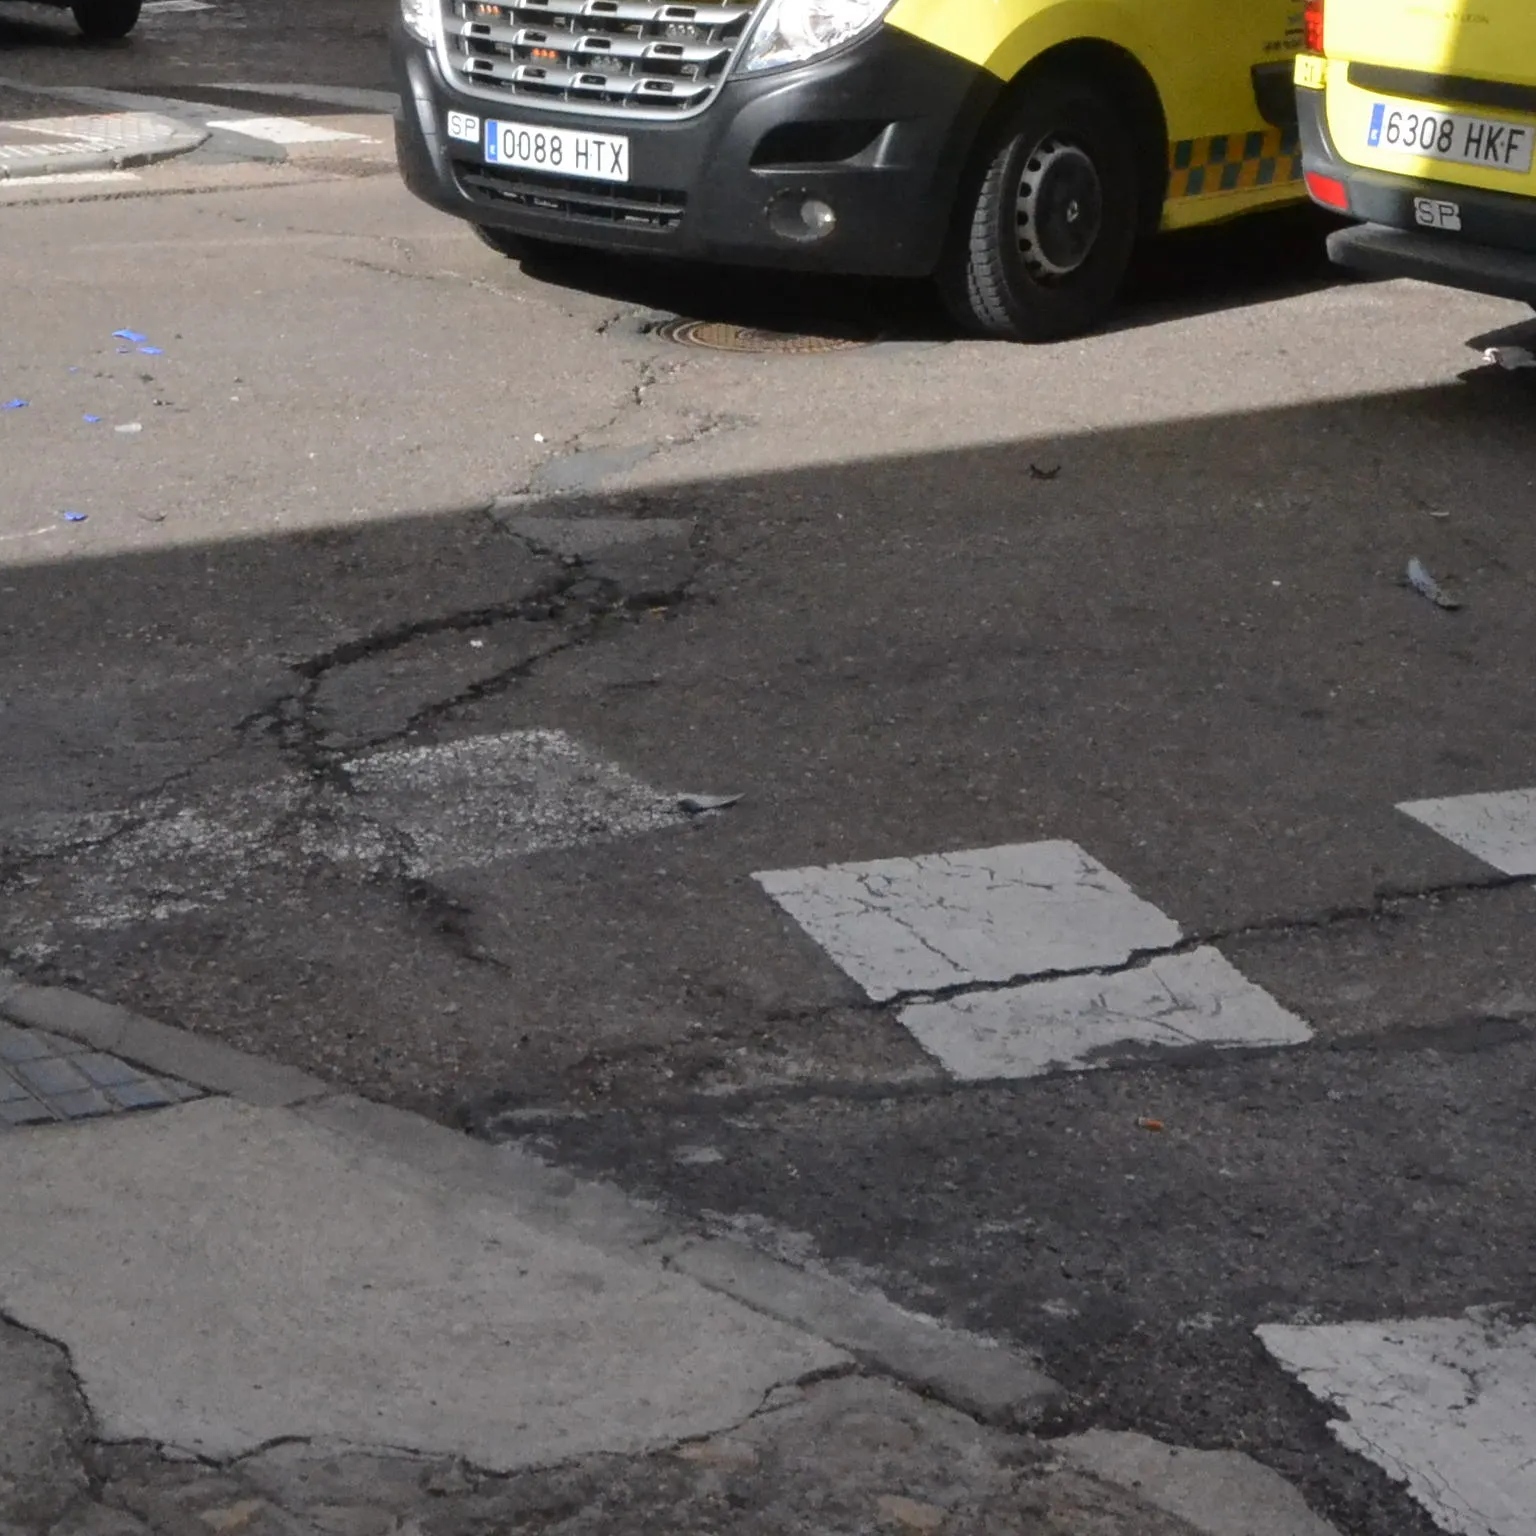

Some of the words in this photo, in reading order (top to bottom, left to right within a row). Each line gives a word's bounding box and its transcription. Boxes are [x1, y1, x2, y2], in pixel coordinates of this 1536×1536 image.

[450, 114, 476, 138] SP
[1385, 110, 1453, 154] 6308
[1463, 120, 1526, 165] HKF
[502, 128, 564, 167] 0088
[574, 137, 624, 176] HTX
[1416, 199, 1459, 228] SP
